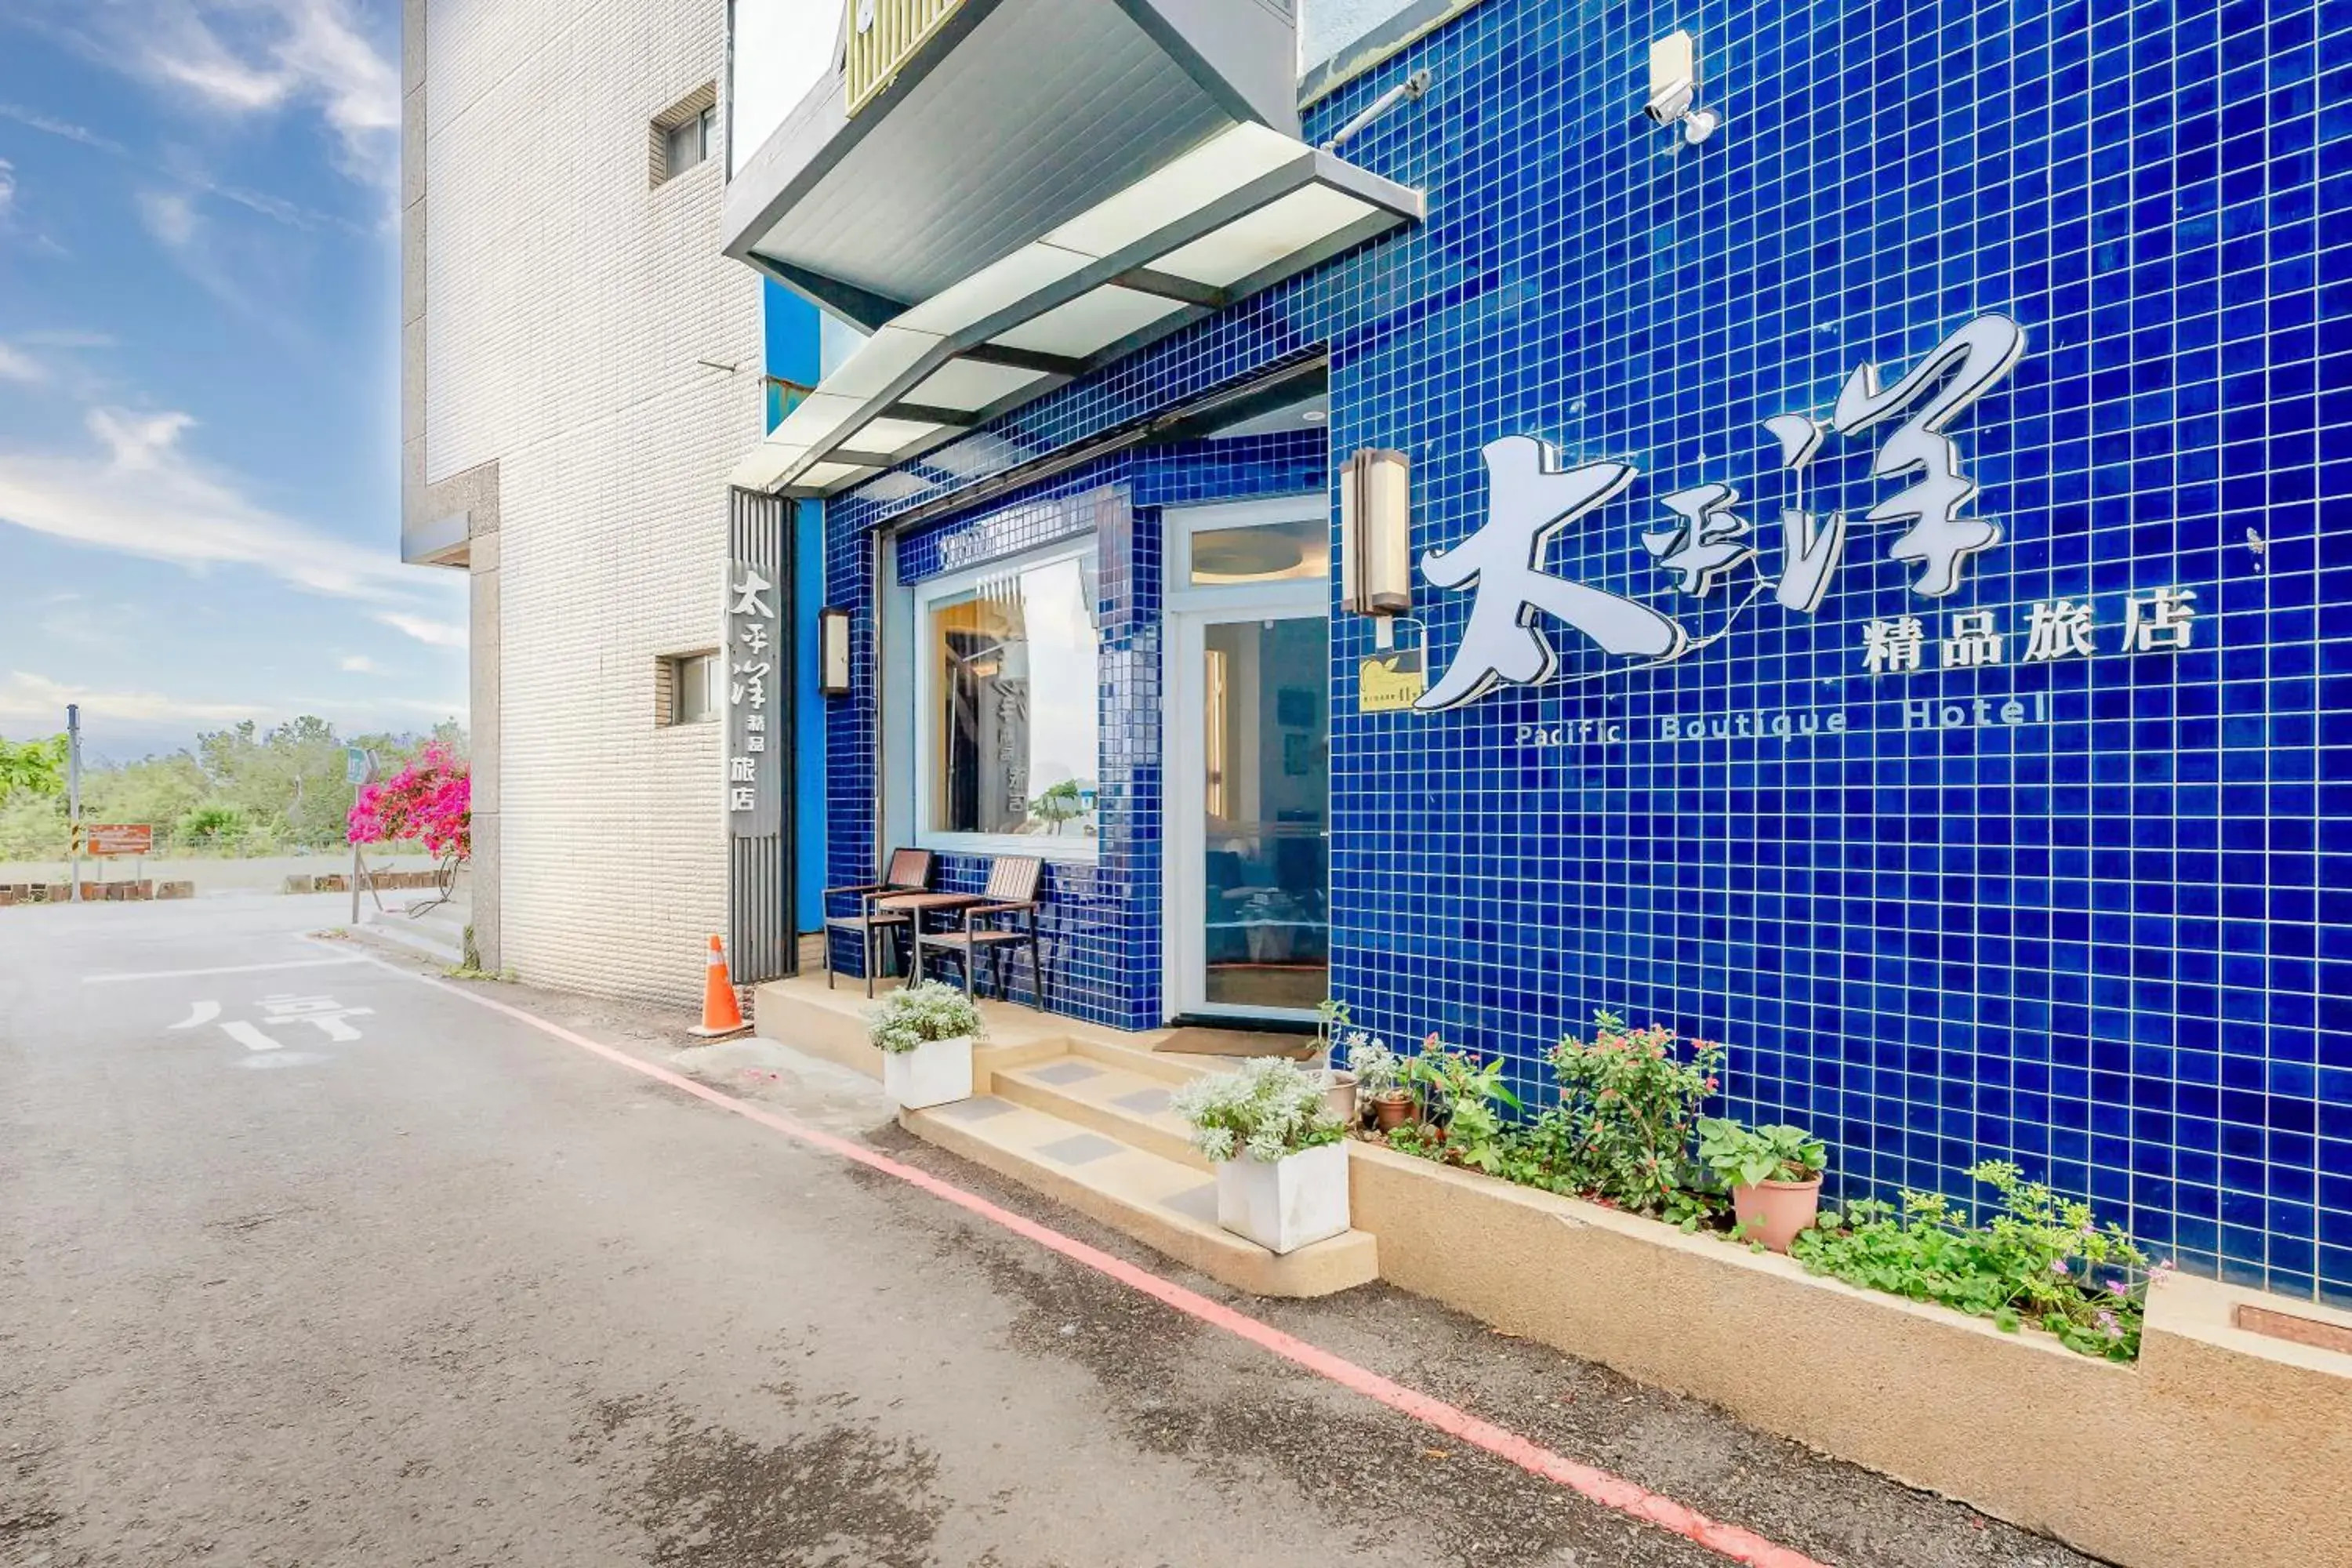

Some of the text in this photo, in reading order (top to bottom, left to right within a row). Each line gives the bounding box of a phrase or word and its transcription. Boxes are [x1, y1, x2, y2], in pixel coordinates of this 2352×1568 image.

[1412, 312, 2026, 712] 太平洋
[1862, 588, 2197, 673] 精品旅店
[1516, 692, 2044, 746] Pacific Boutique Hotel
